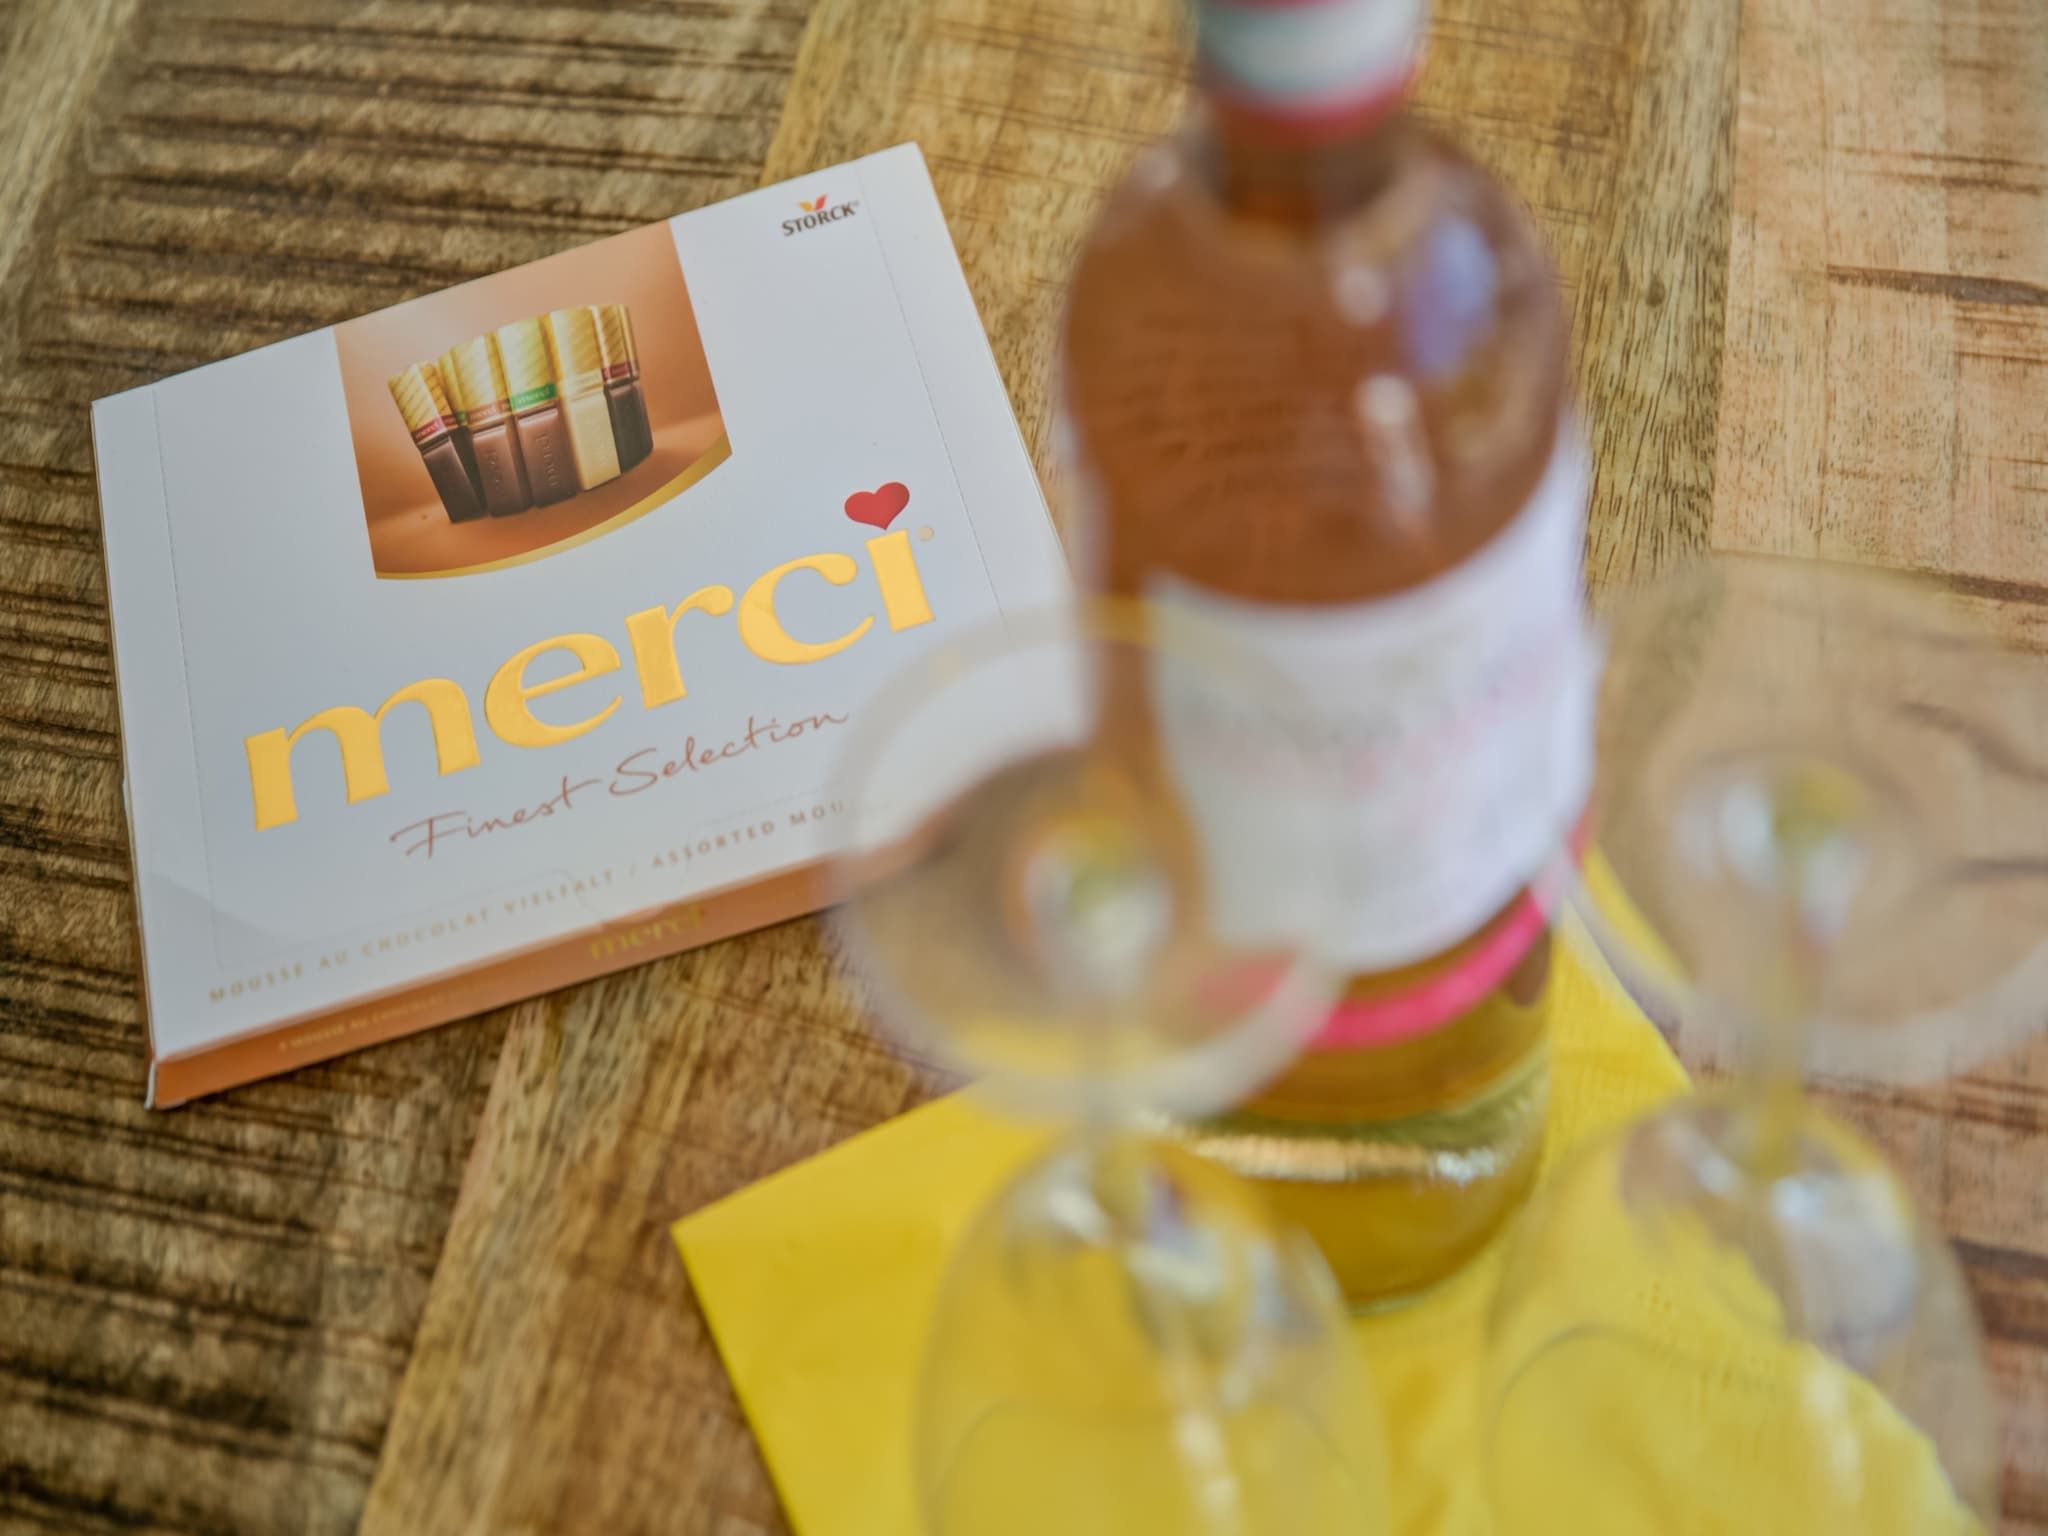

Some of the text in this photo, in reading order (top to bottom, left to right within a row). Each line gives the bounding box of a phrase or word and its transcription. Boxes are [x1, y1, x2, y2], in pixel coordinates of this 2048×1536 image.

[781, 203, 857, 237] STORCK
[244, 482, 936, 831] merci
[389, 712, 848, 859] Finest Selection
[208, 961, 304, 1003] MOUSSE
[319, 950, 349, 970] AU
[361, 906, 490, 958] CHOCOLAT
[504, 868, 613, 914] VIELFALT
[652, 820, 775, 869] ASSORTED
